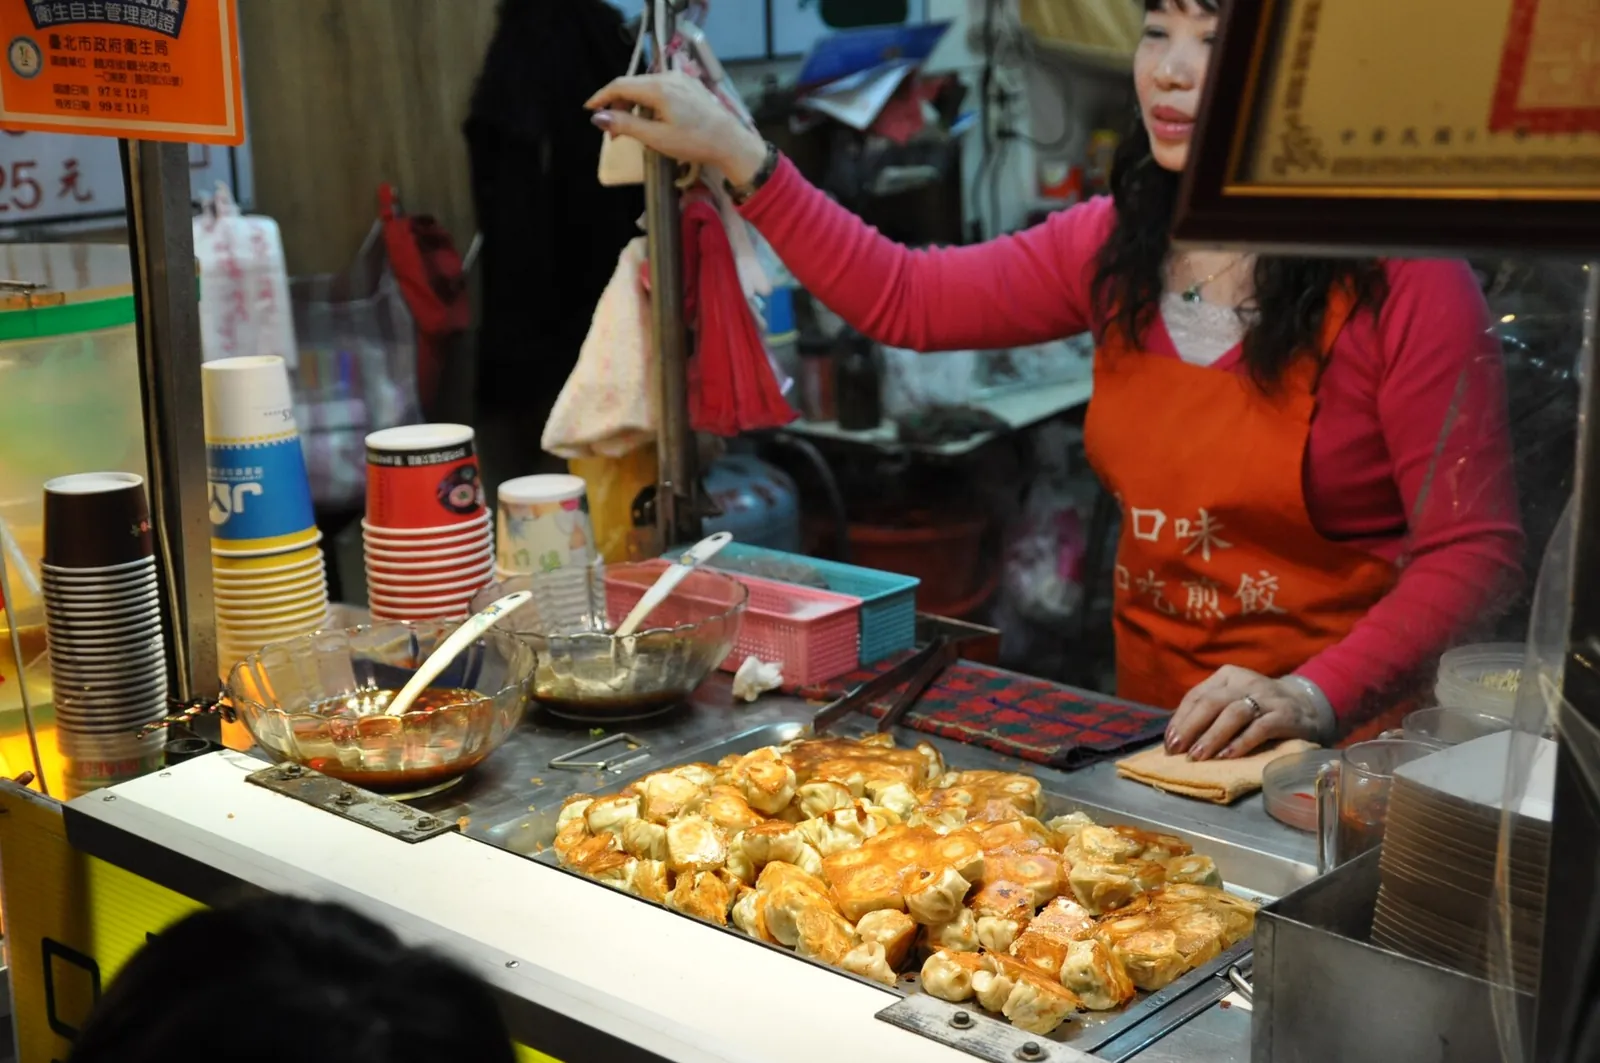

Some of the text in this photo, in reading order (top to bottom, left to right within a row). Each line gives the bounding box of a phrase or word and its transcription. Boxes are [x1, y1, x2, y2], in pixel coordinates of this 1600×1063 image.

[34, 1, 176, 34] 衛生自主管理認證
[1115, 492, 1234, 562] 口味
